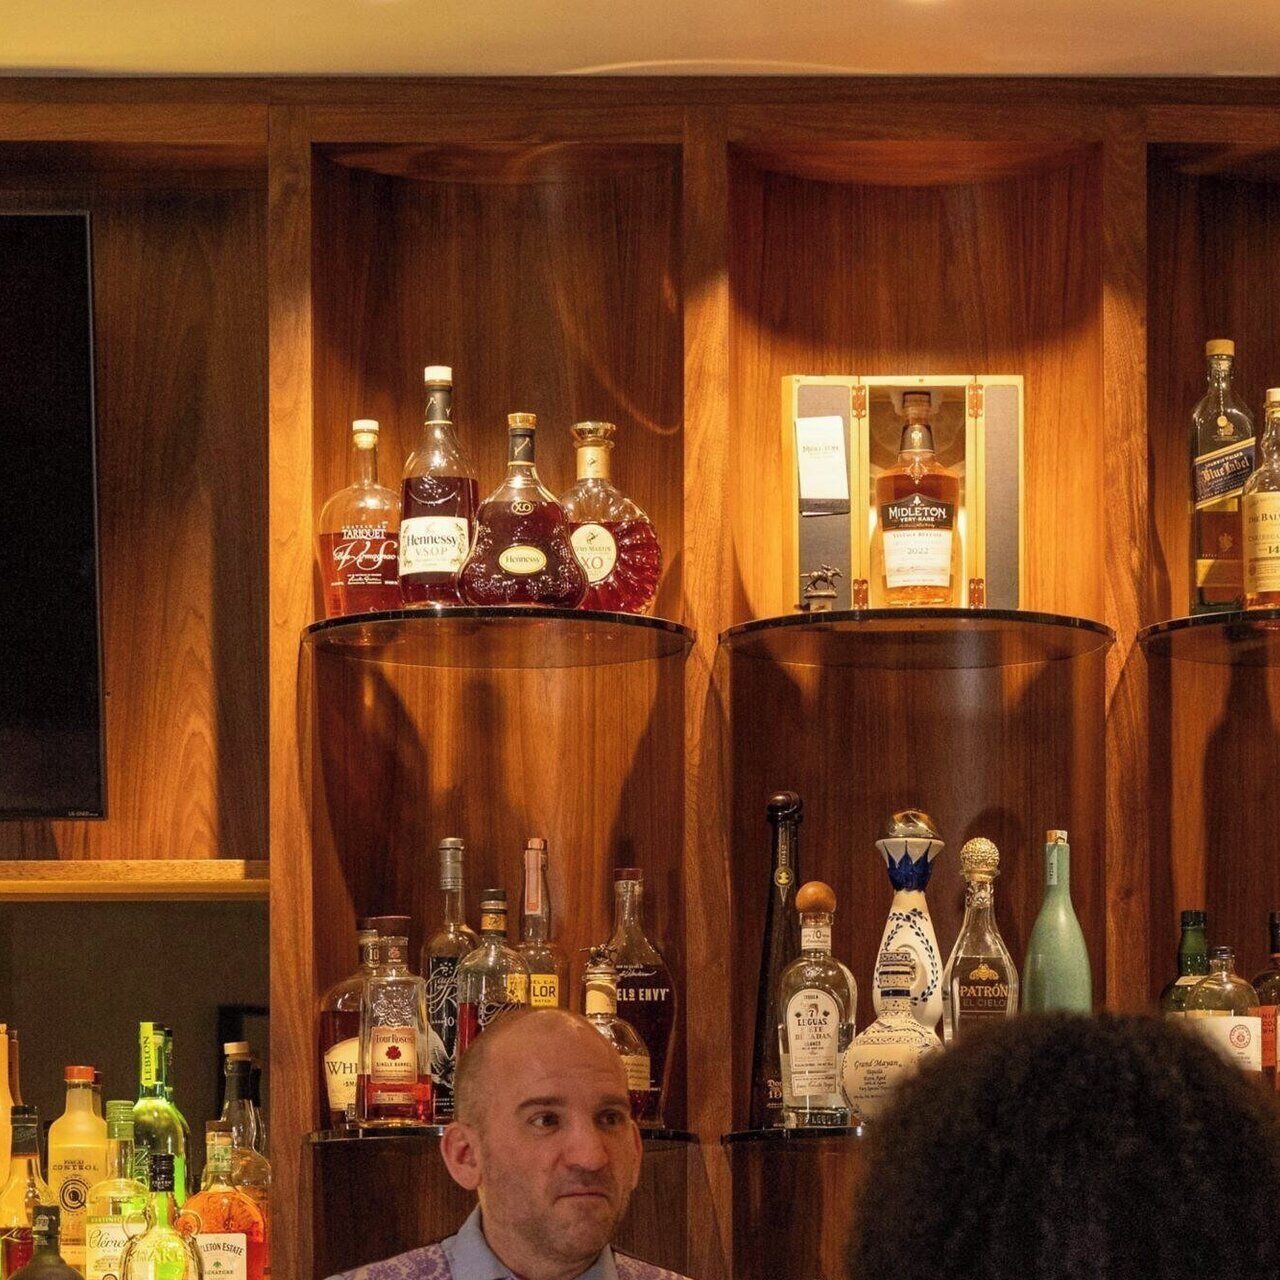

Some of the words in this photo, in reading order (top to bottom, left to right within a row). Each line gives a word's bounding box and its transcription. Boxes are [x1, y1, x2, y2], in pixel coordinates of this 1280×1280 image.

[889, 507, 947, 519] MIDLETON
[342, 529, 386, 540] TARIQUET
[407, 533, 457, 547] Hennessy
[506, 556, 540, 565] Hennessy
[639, 988, 667, 1001] ENVY
[960, 983, 1008, 997] PATRÓN
[143, 1035, 152, 1081] LEBLON
[222, 1243, 244, 1257] ESTATE
